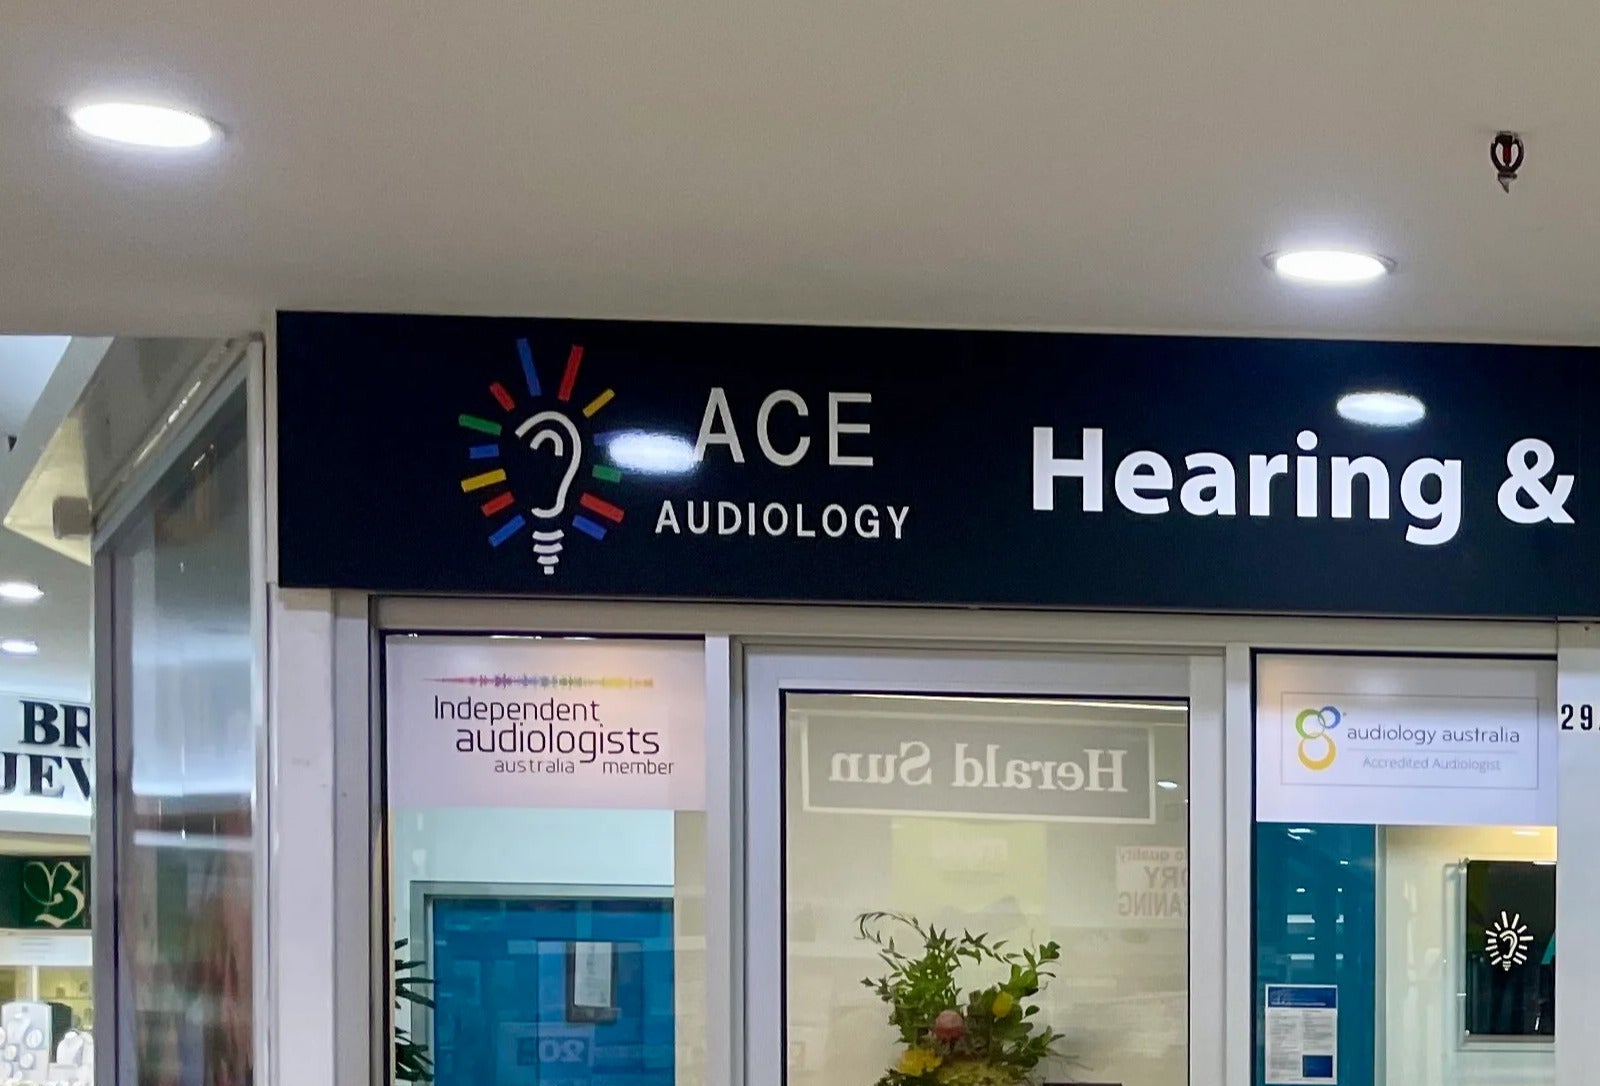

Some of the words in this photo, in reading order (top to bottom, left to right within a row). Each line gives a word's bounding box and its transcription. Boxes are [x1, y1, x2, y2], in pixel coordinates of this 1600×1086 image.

[694, 386, 874, 467] ACE
[1031, 427, 1462, 547] Hearing
[1497, 438, 1575, 525] &
[655, 500, 910, 540] AUDIOLOGY
[434, 695, 600, 725] Independent
[456, 722, 660, 763] audiologists
[1347, 724, 1436, 745] audiology
[1442, 726, 1520, 744] australia
[494, 758, 575, 774] australia
[602, 760, 674, 776] member
[1362, 755, 1429, 770] Accredited
[1432, 757, 1502, 774] Audiologist
